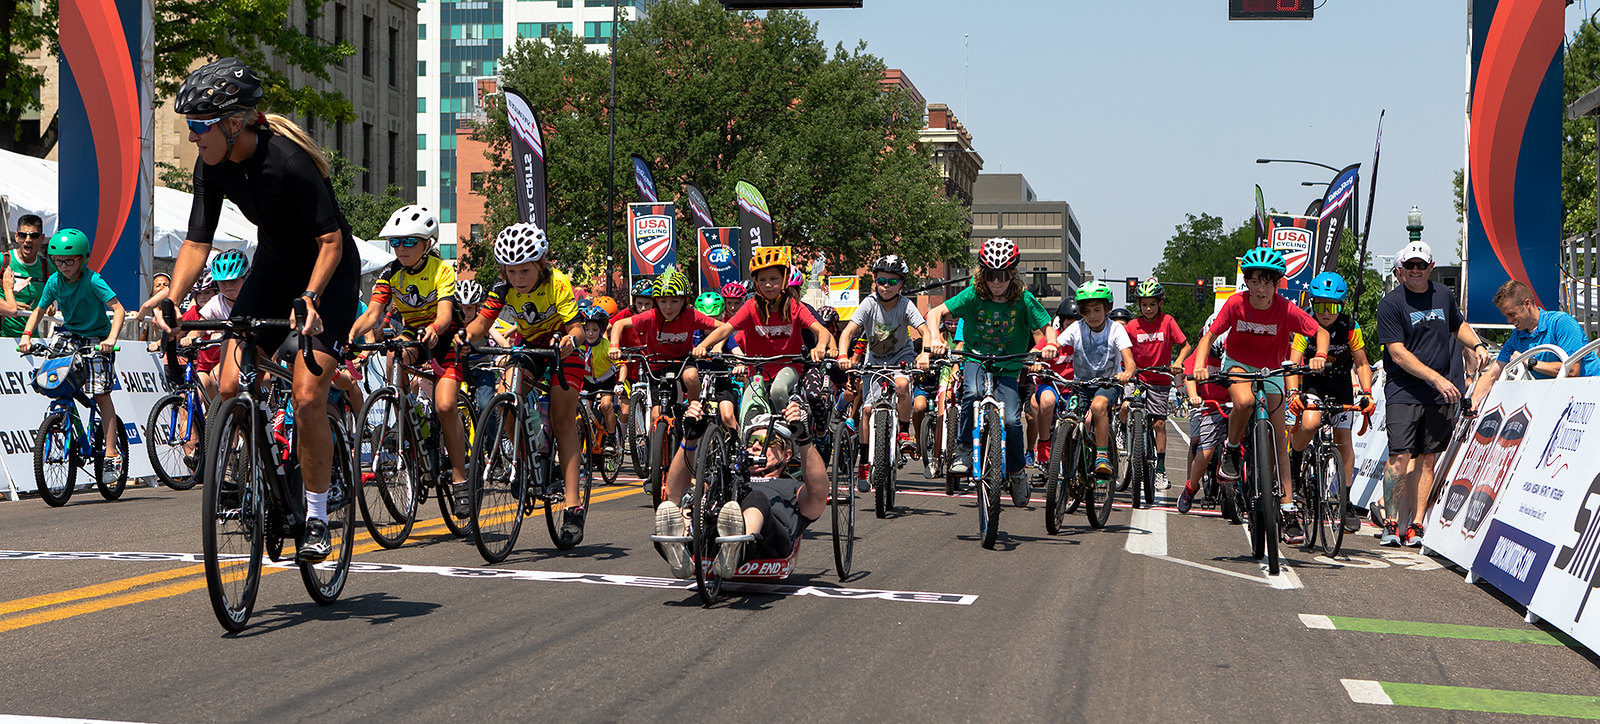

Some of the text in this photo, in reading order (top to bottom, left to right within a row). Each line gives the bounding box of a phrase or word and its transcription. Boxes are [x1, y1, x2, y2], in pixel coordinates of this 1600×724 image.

[638, 219, 667, 230] USA
[638, 228, 668, 236] CYCLING
[1277, 231, 1307, 244] USA
[1324, 217, 1338, 253] CRITS
[1276, 241, 1307, 250] CYCLING
[709, 253, 729, 263] CAF
[121, 371, 159, 393] BAILEY
[758, 561, 782, 575] END
